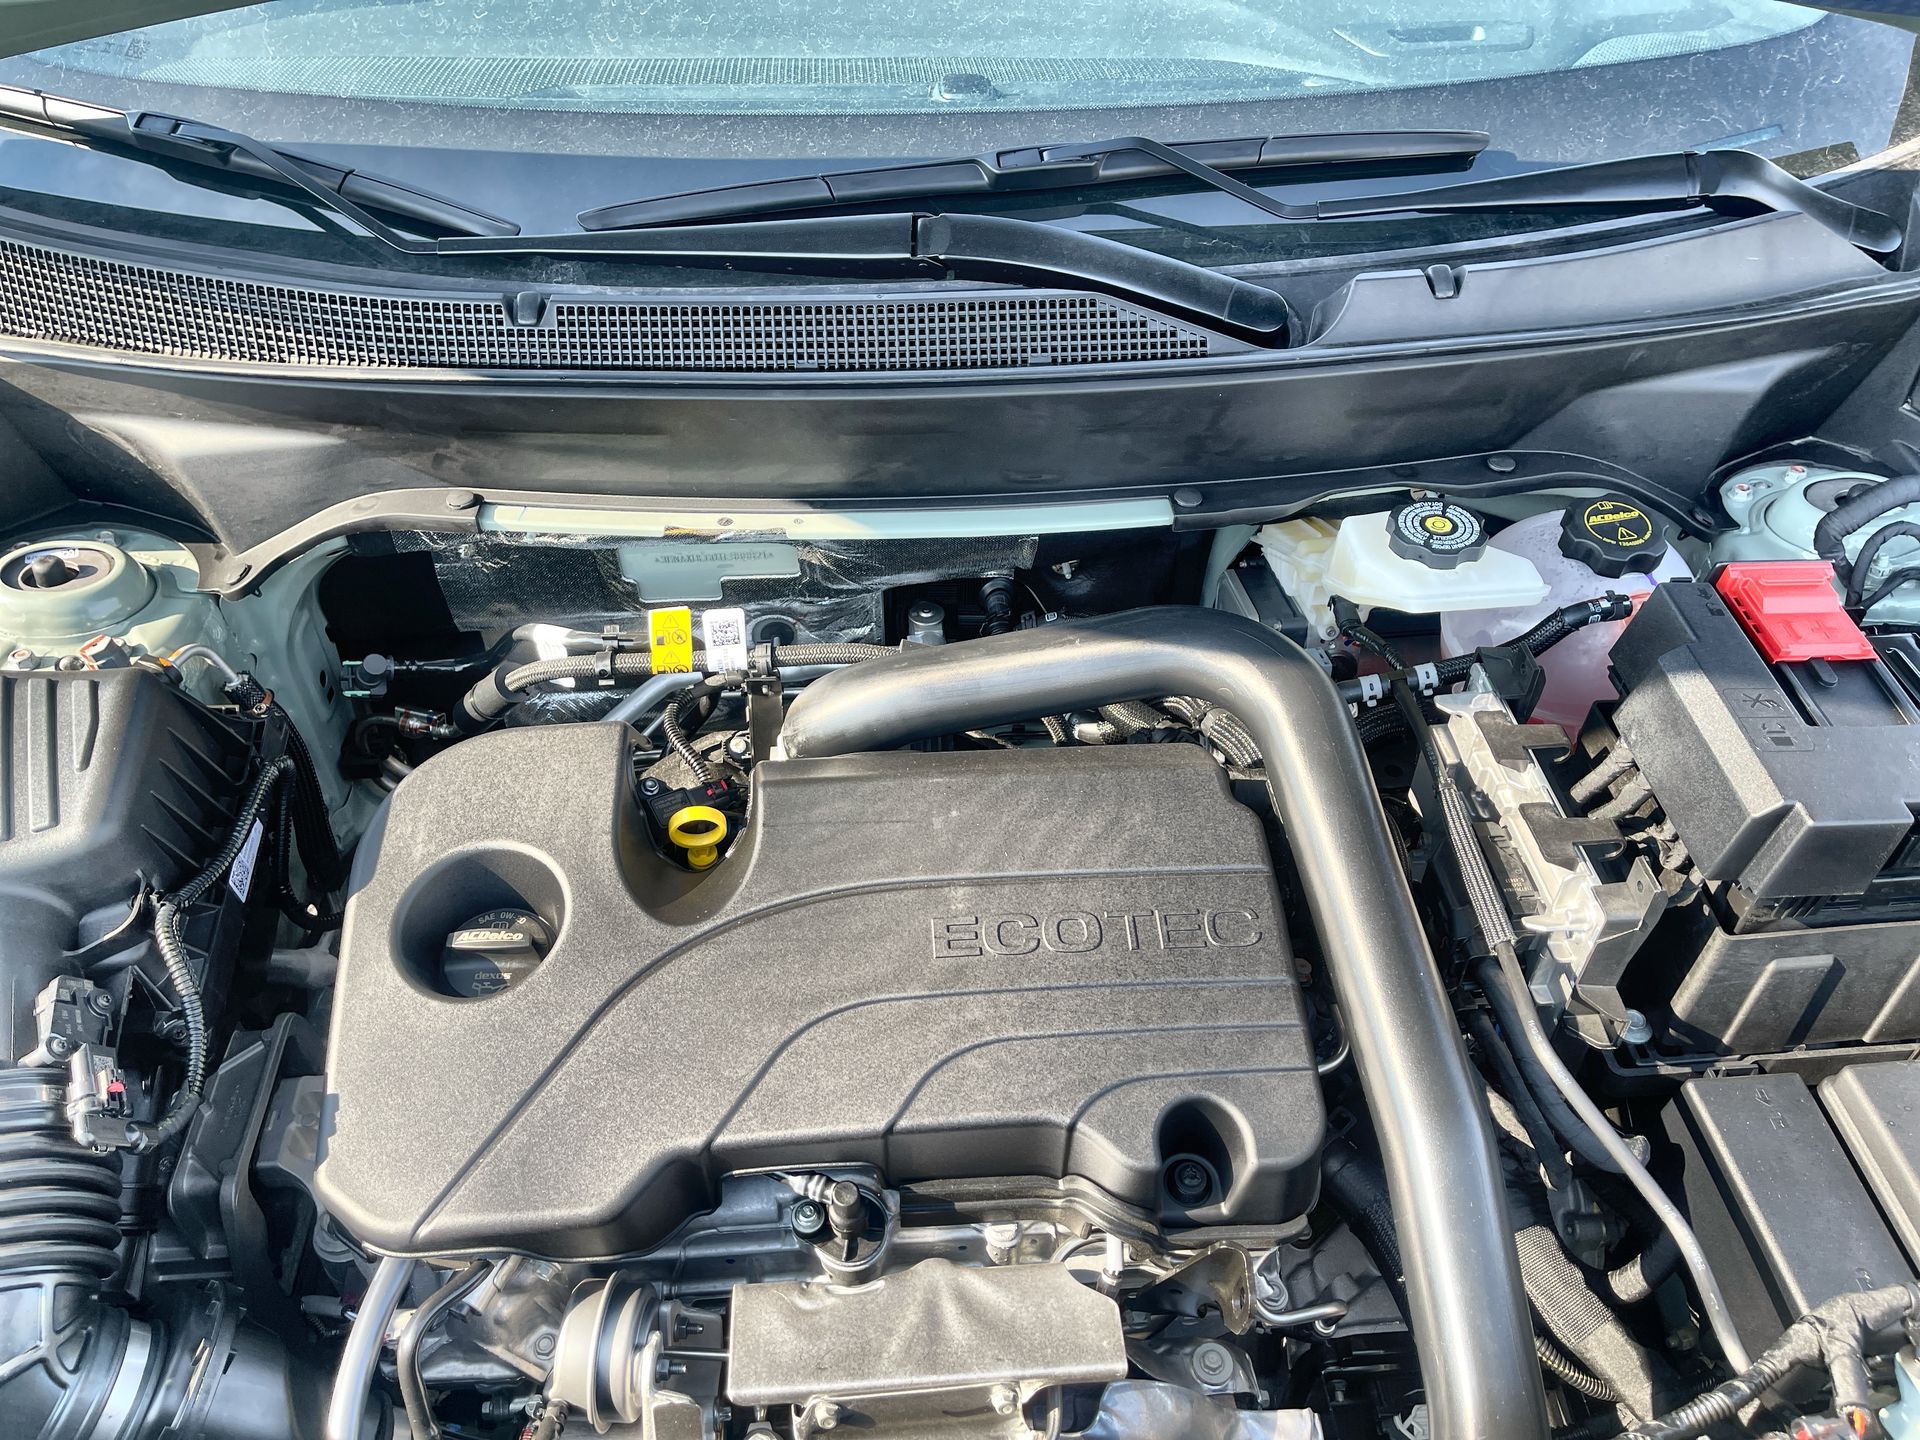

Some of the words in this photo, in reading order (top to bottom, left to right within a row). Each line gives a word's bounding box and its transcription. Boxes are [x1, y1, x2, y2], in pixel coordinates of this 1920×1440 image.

[1589, 511, 1639, 523] ACDelco
[479, 913, 496, 924] SAE
[456, 931, 523, 940] ACDelco
[931, 905, 1263, 959] ECOTEC
